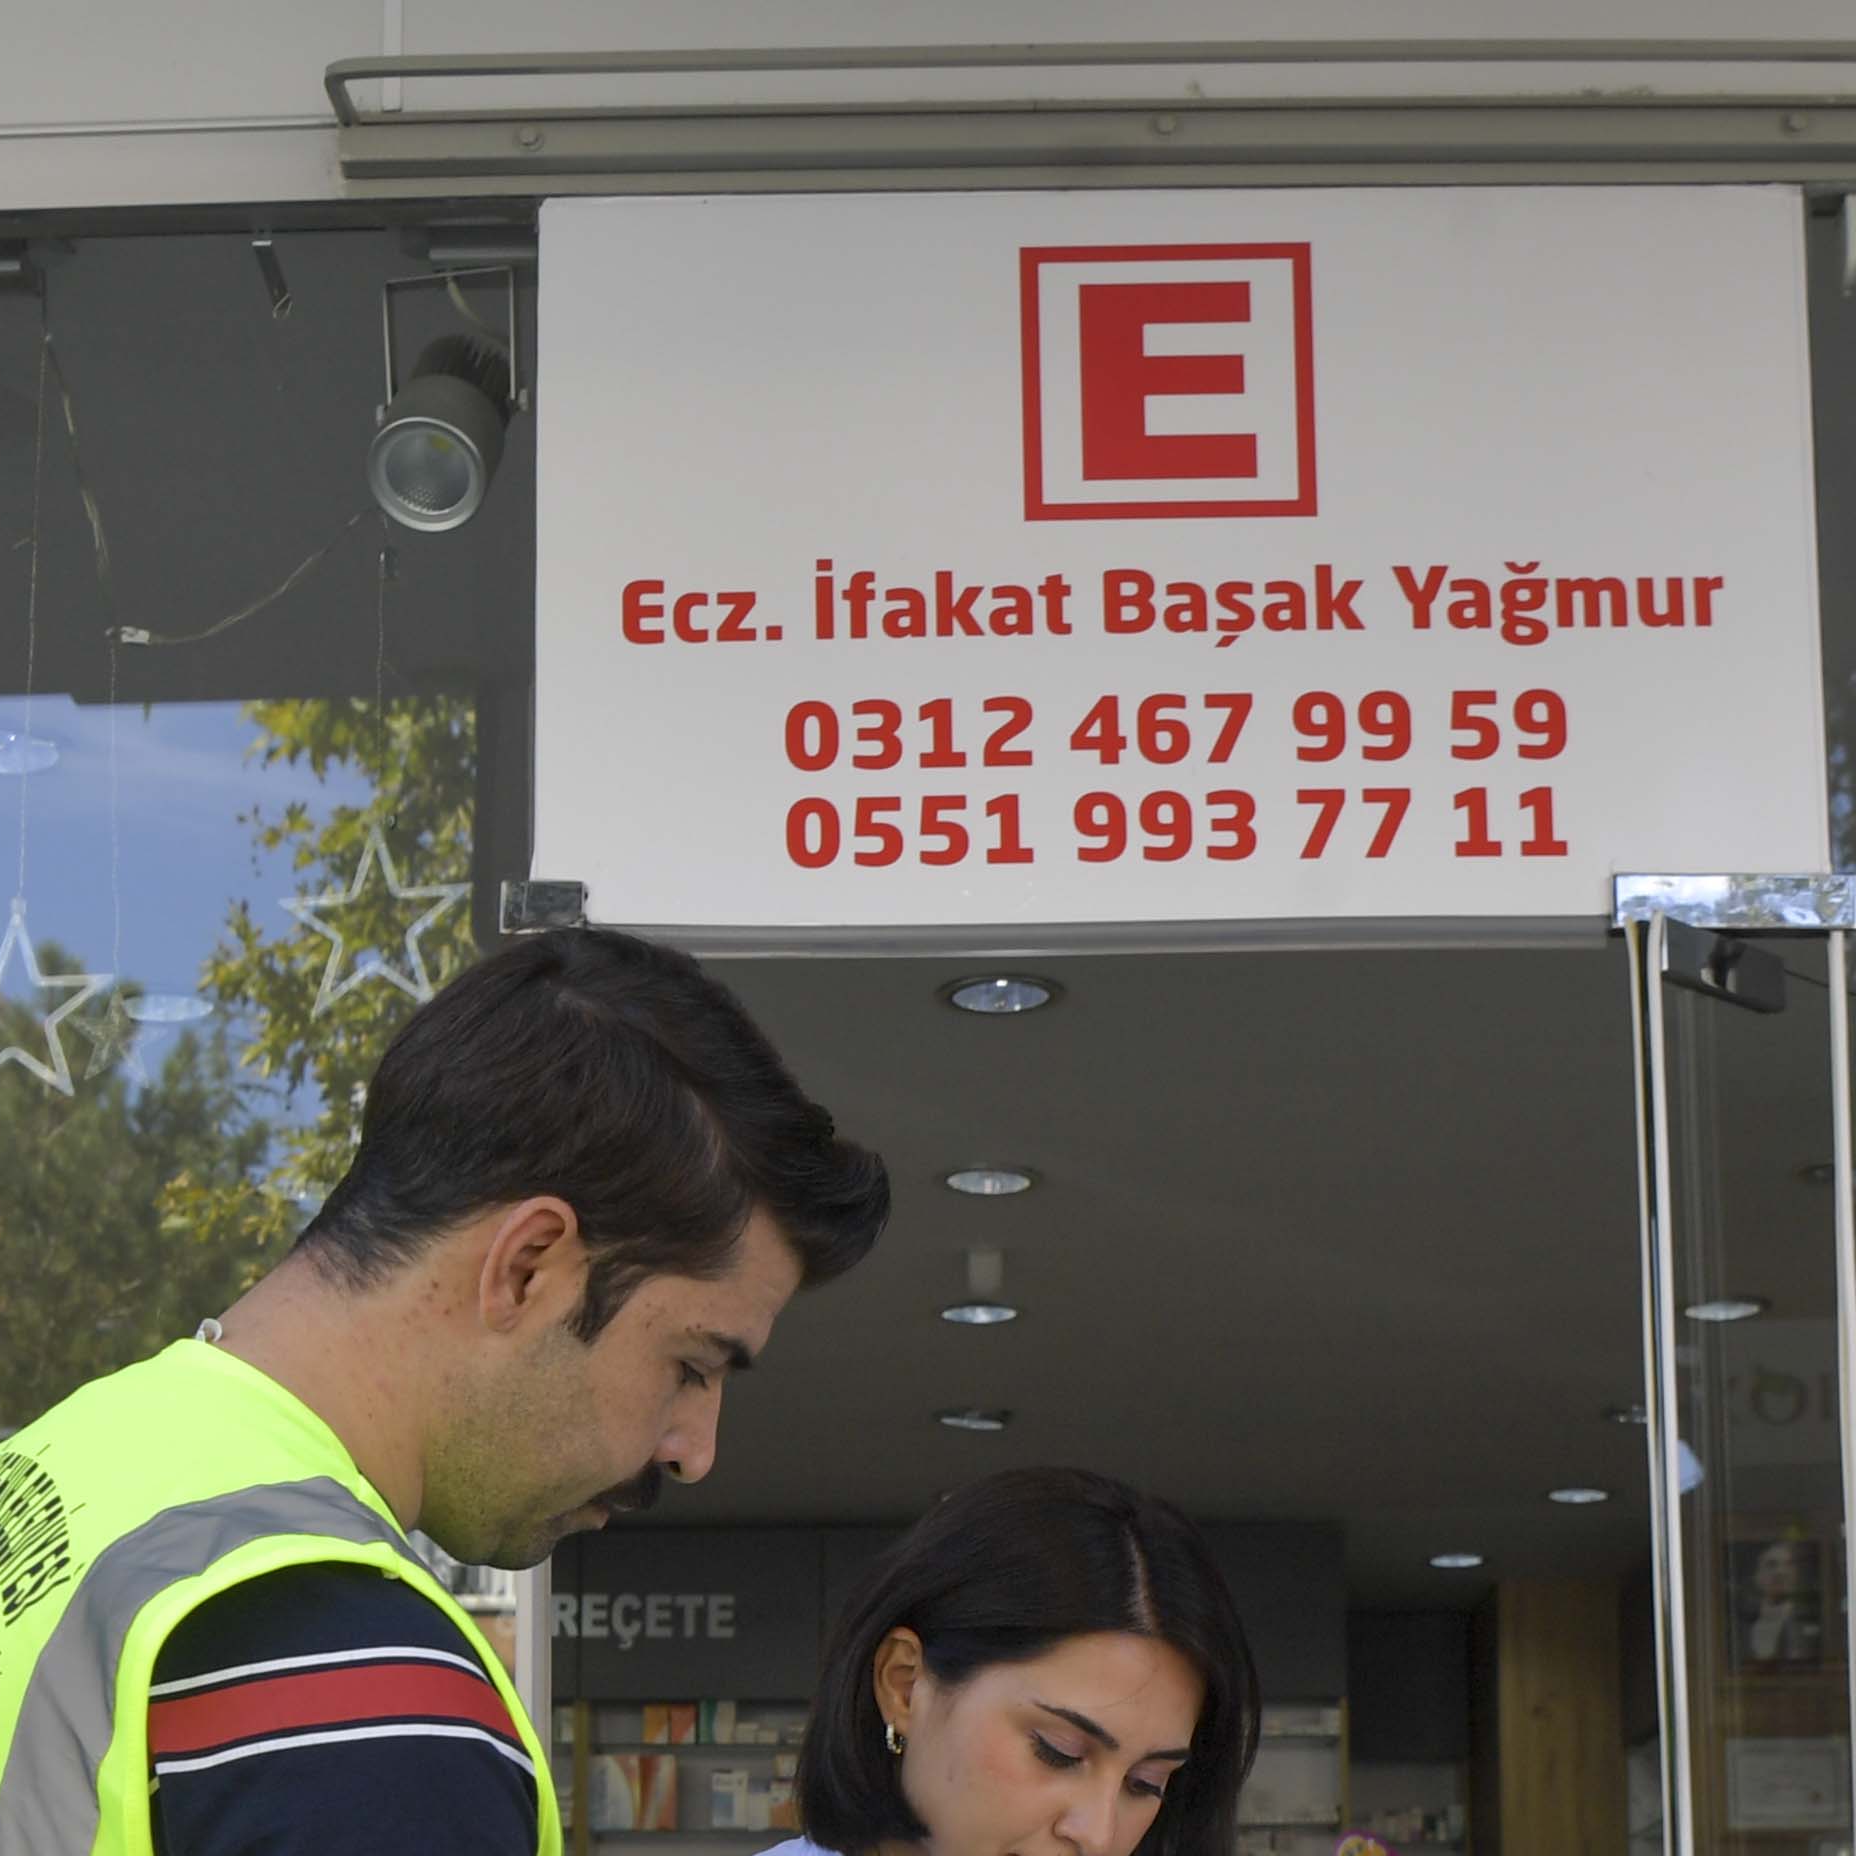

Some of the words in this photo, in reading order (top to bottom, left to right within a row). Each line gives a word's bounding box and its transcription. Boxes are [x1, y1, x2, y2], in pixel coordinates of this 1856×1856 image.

[1079, 281, 1257, 480] E
[622, 579, 783, 645] Ecz.
[814, 559, 1072, 640] İfakat
[1103, 564, 1366, 648] Başak
[1392, 561, 1724, 646] Yağmur
[785, 697, 1034, 771] 0312
[1070, 694, 1254, 765] 467
[1291, 690, 1414, 761] 99
[1449, 687, 1570, 759] 59
[786, 793, 1034, 868] 0551
[1073, 790, 1258, 863] 993
[1297, 788, 1412, 860] 77
[1453, 785, 1569, 858] 11
[551, 1593, 737, 1650] REÇETE
